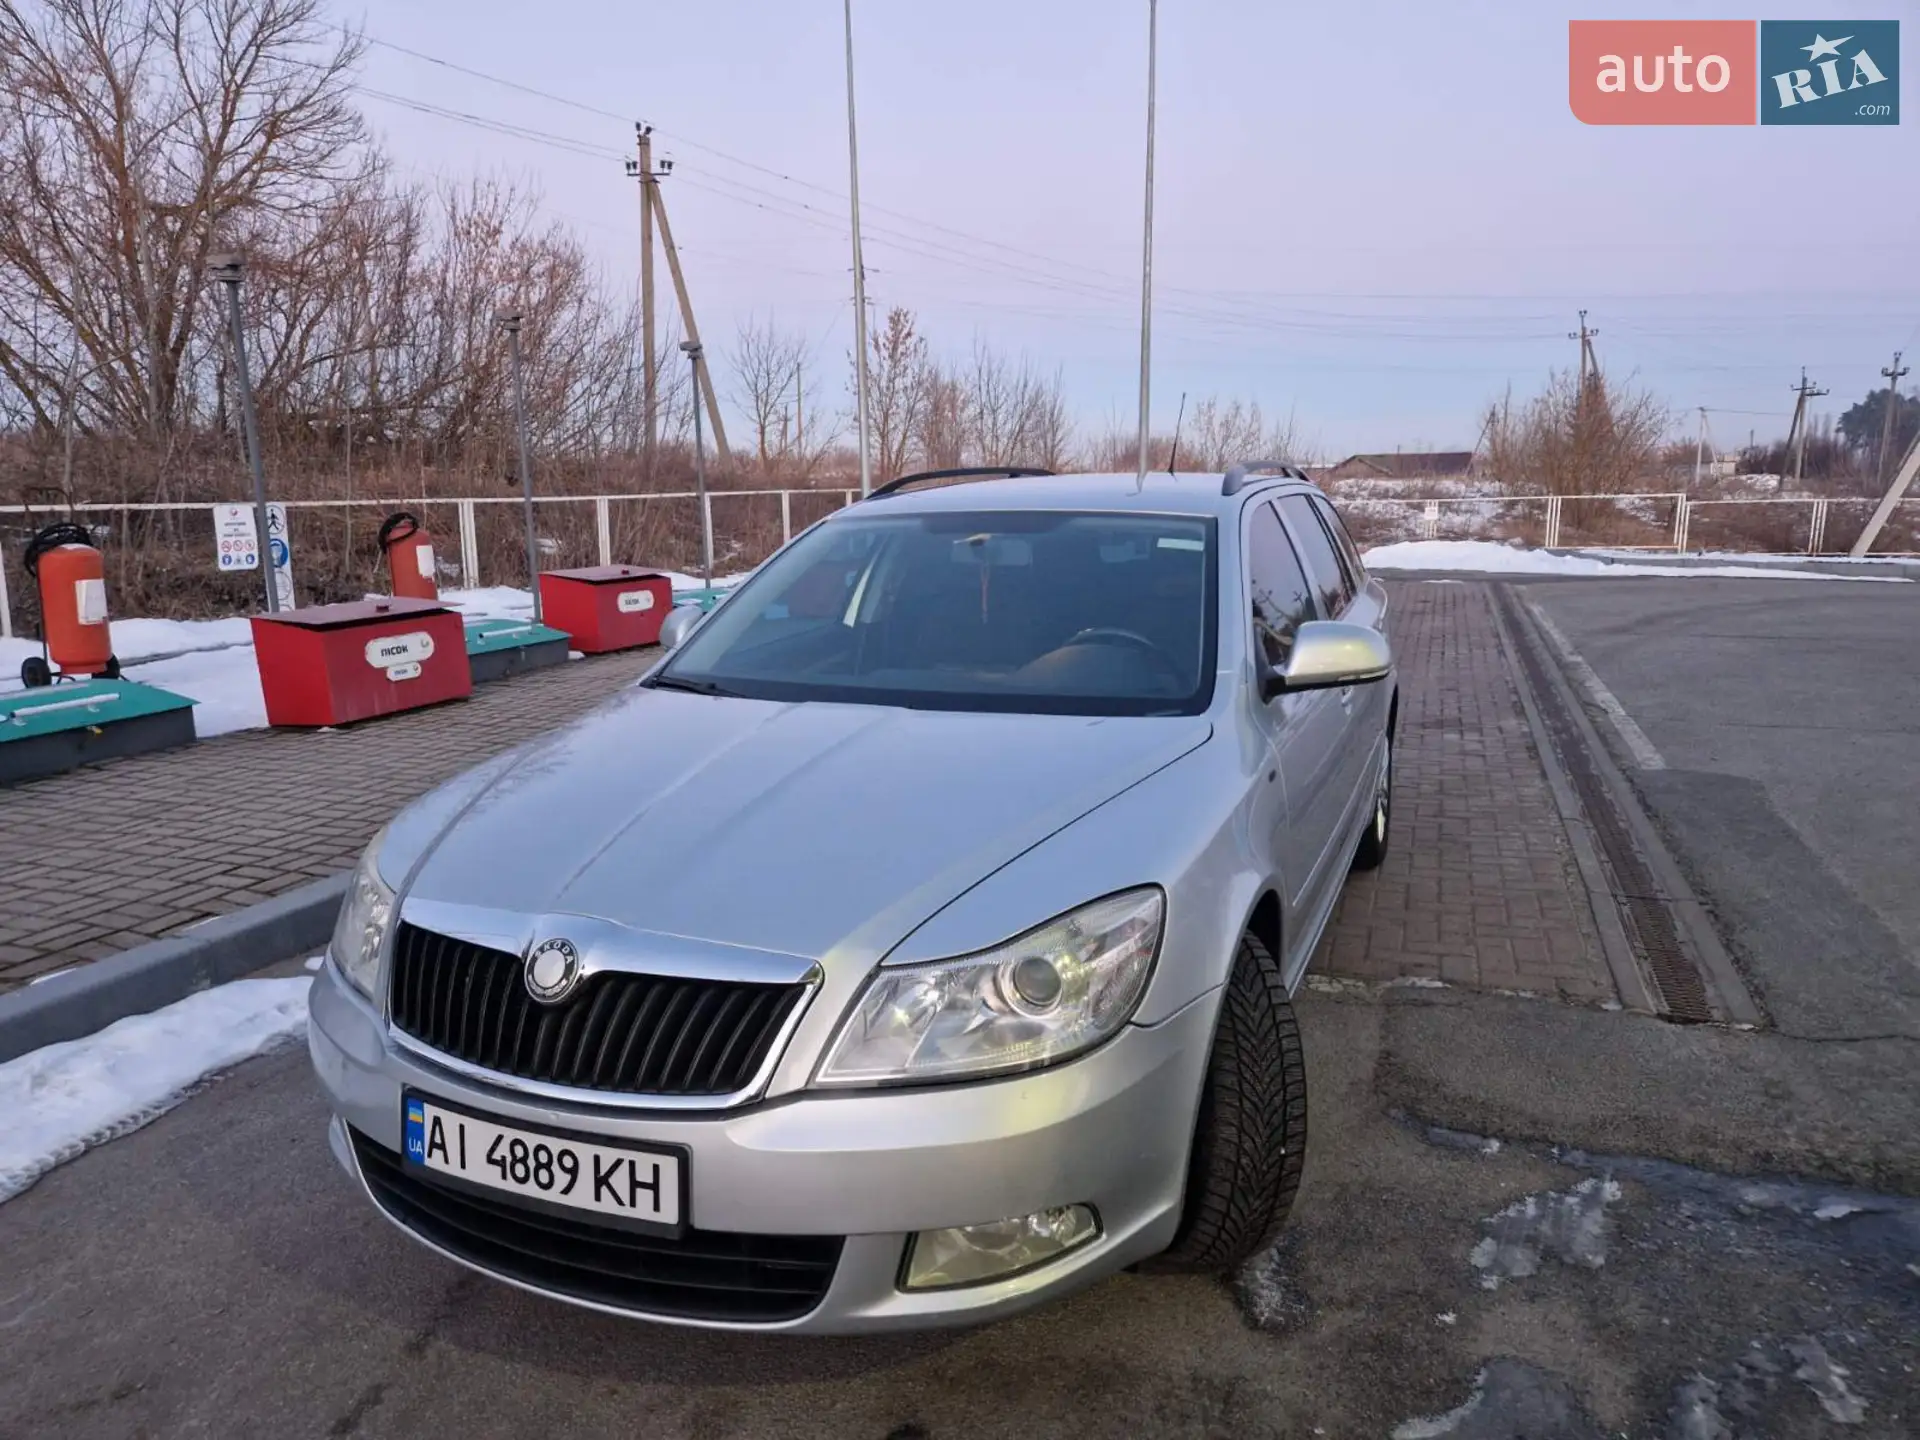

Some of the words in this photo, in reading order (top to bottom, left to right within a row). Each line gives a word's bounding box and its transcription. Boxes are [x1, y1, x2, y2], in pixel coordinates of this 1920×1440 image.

[408, 1137, 423, 1153] UA
[427, 1115, 467, 1170] AI
[486, 1134, 580, 1195] 4889
[593, 1154, 661, 1213] KH
